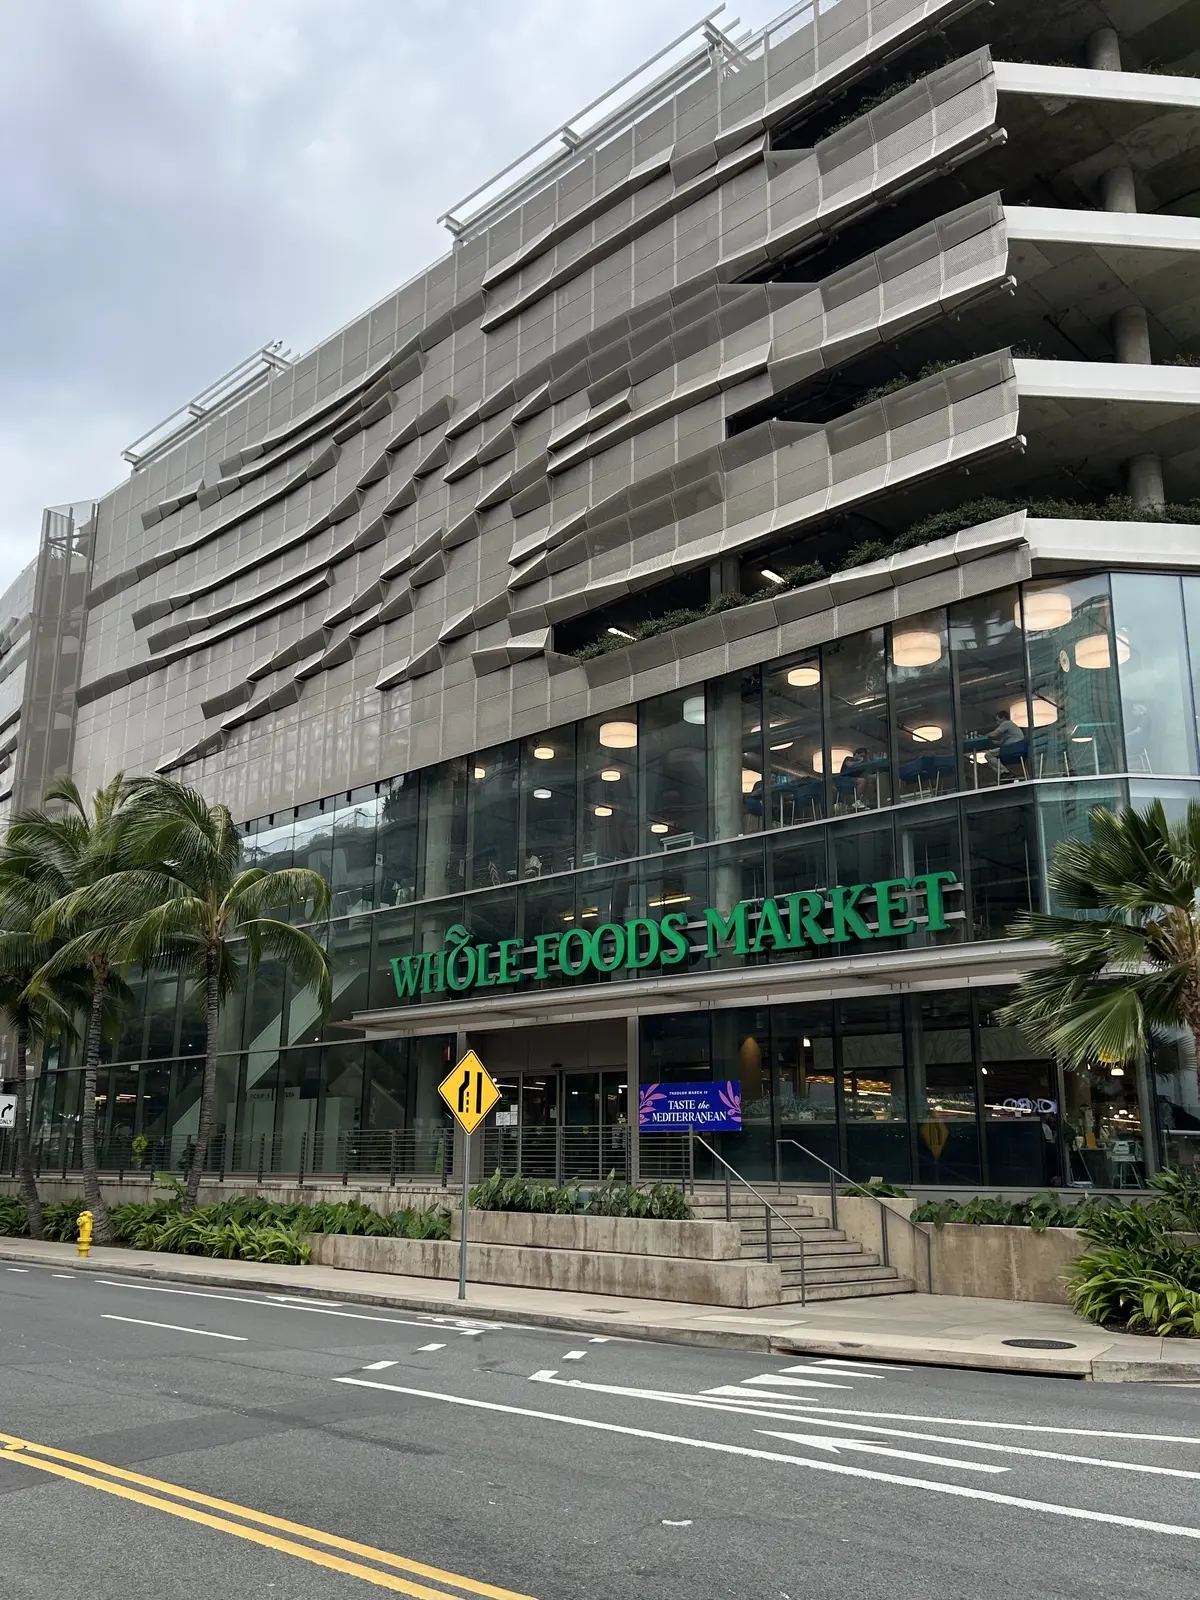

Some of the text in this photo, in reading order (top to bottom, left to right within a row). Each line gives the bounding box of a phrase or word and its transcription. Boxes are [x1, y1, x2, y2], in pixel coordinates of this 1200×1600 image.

[389, 871, 957, 998] WHOLE FOODS MARKET
[668, 1100, 709, 1110] TASTE the
[652, 1111, 727, 1124] MEDITERRANEAN
